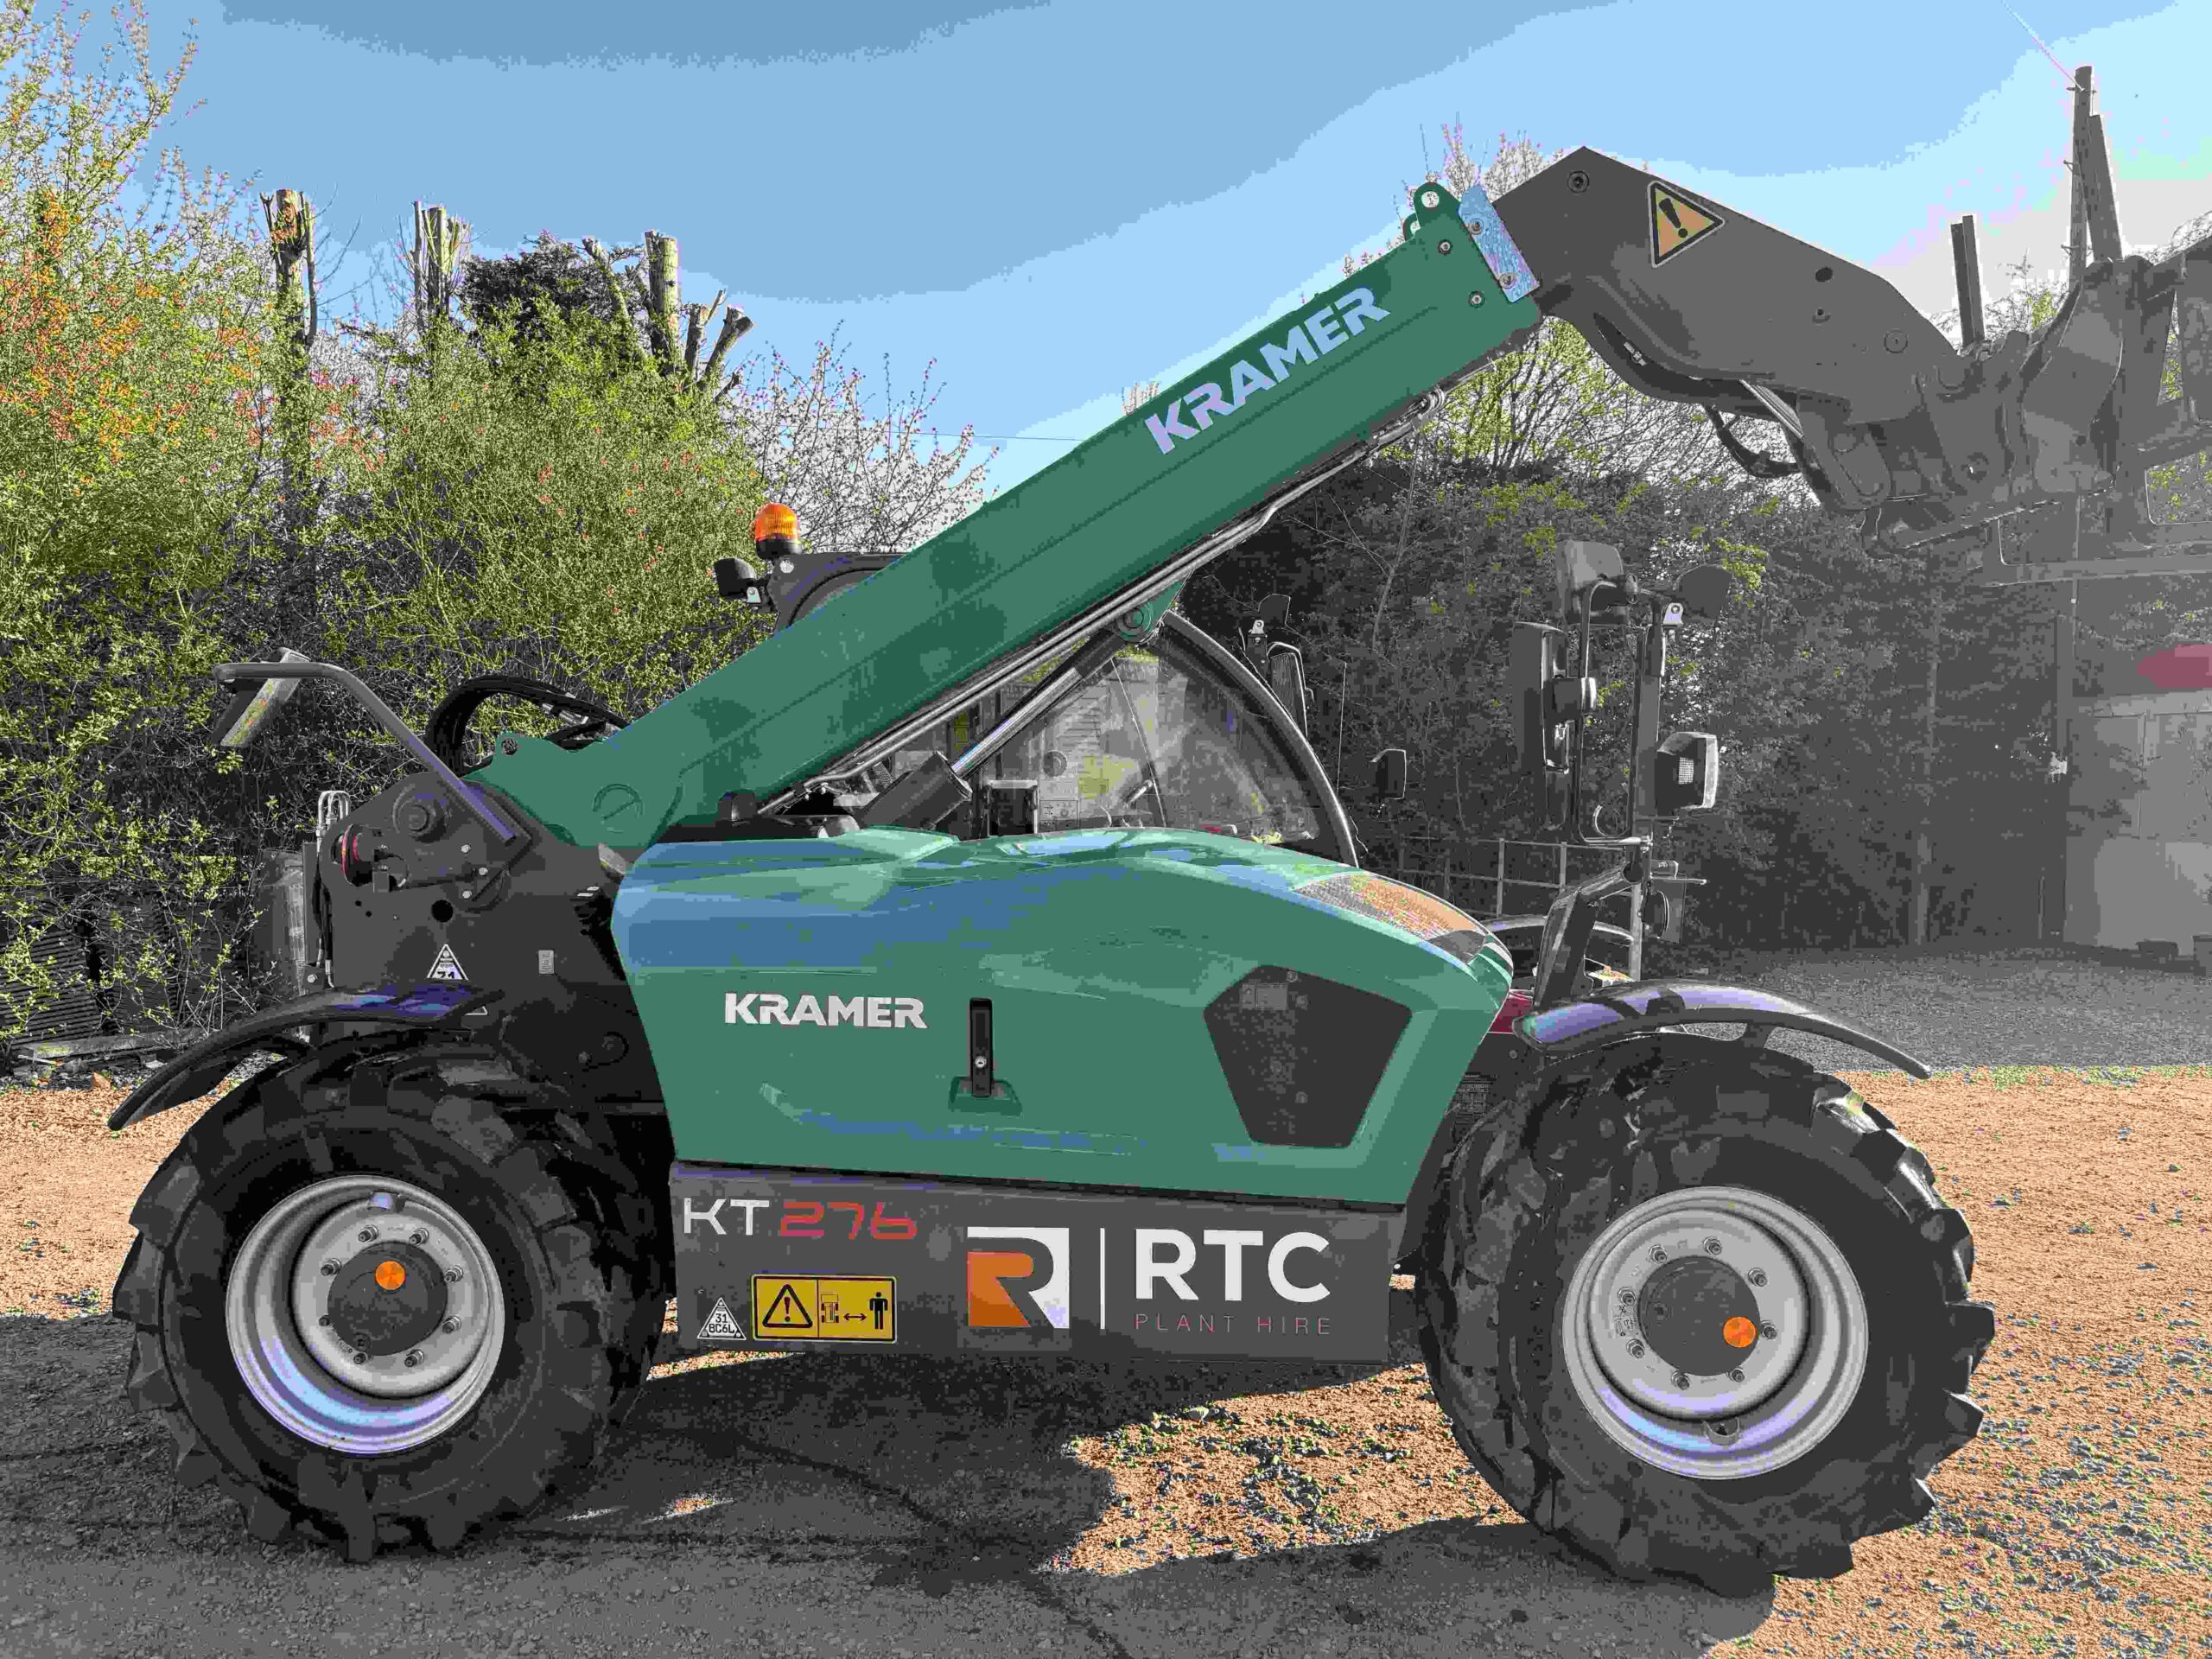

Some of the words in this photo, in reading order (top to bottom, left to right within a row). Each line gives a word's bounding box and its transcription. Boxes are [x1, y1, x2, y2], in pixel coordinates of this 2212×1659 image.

[1145, 287, 1390, 454] KRAMER
[725, 993, 927, 1029] KRAMER
[683, 1198, 769, 1236] KT
[780, 1201, 918, 1239] 276
[1135, 1228, 1331, 1303] RTC
[715, 1313, 728, 1323] 31
[1135, 1313, 1237, 1333] PLANT
[1257, 1316, 1331, 1335] HIRE
